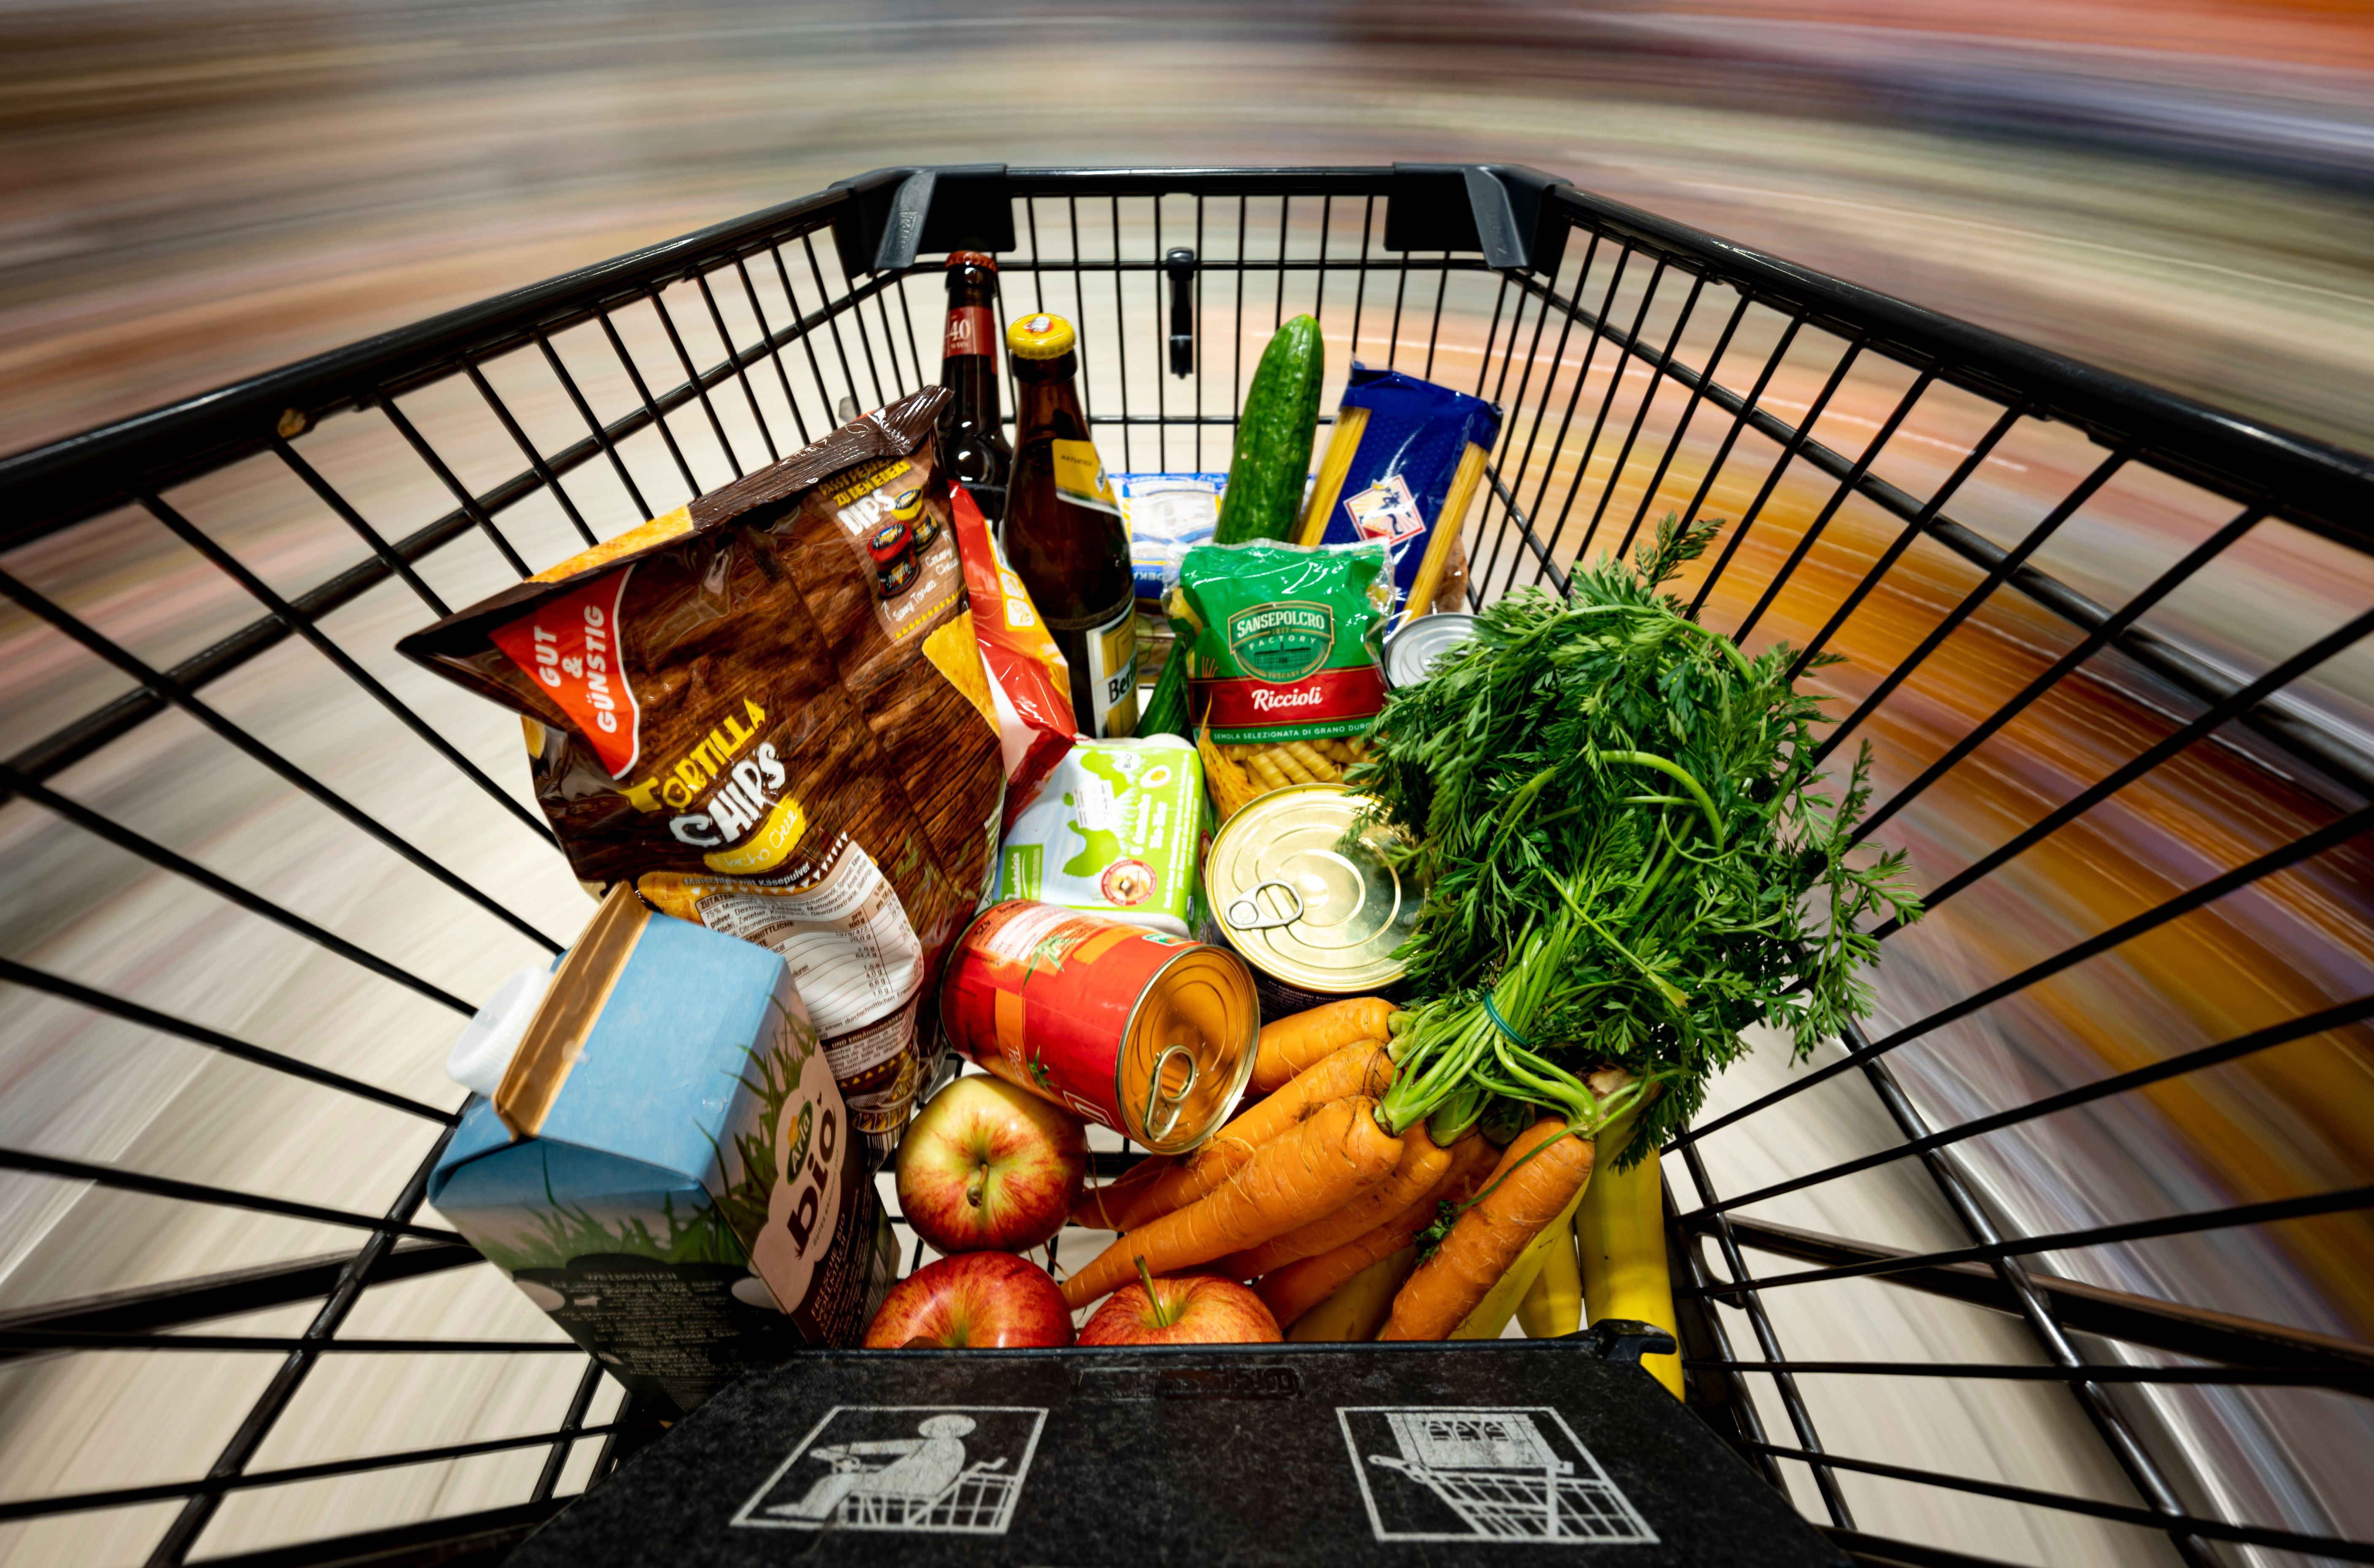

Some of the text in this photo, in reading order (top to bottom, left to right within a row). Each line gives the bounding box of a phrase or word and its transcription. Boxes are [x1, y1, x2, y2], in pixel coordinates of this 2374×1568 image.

[833, 460, 911, 507] ZU DEN EDEKA
[836, 488, 896, 537] DIPS
[1133, 571, 1165, 581] DEKA
[1237, 610, 1325, 638] SANSEPOLCRO
[1249, 635, 1316, 651] FACTORY
[534, 625, 561, 687] GUT
[562, 656, 583, 679] &
[584, 605, 616, 733] GÜNSTIG
[1108, 655, 1137, 704] Berl
[1252, 687, 1322, 711] Riccioli
[616, 698, 766, 813] TORTILLA
[1244, 729, 1299, 739] SELEZIONATA
[1314, 725, 1345, 735] GRANO
[669, 742, 786, 847] CHIPS
[714, 809, 798, 868] Nacho Cheese
[759, 861, 811, 887] Käsepulver
[849, 921, 860, 929] 100
[852, 911, 862, 922] pro
[825, 1022, 843, 1031] einen
[845, 995, 895, 1025] durchschnittlichen
[832, 1039, 846, 1049] UND
[792, 1114, 810, 1174] Arla
[787, 1108, 836, 1258] bio
[813, 1218, 826, 1246] GUTES
[825, 1174, 837, 1215] BRAUCHT
[811, 1213, 845, 1317] FRISCHE BIO
[816, 1235, 846, 1321] VOLLMILCH
